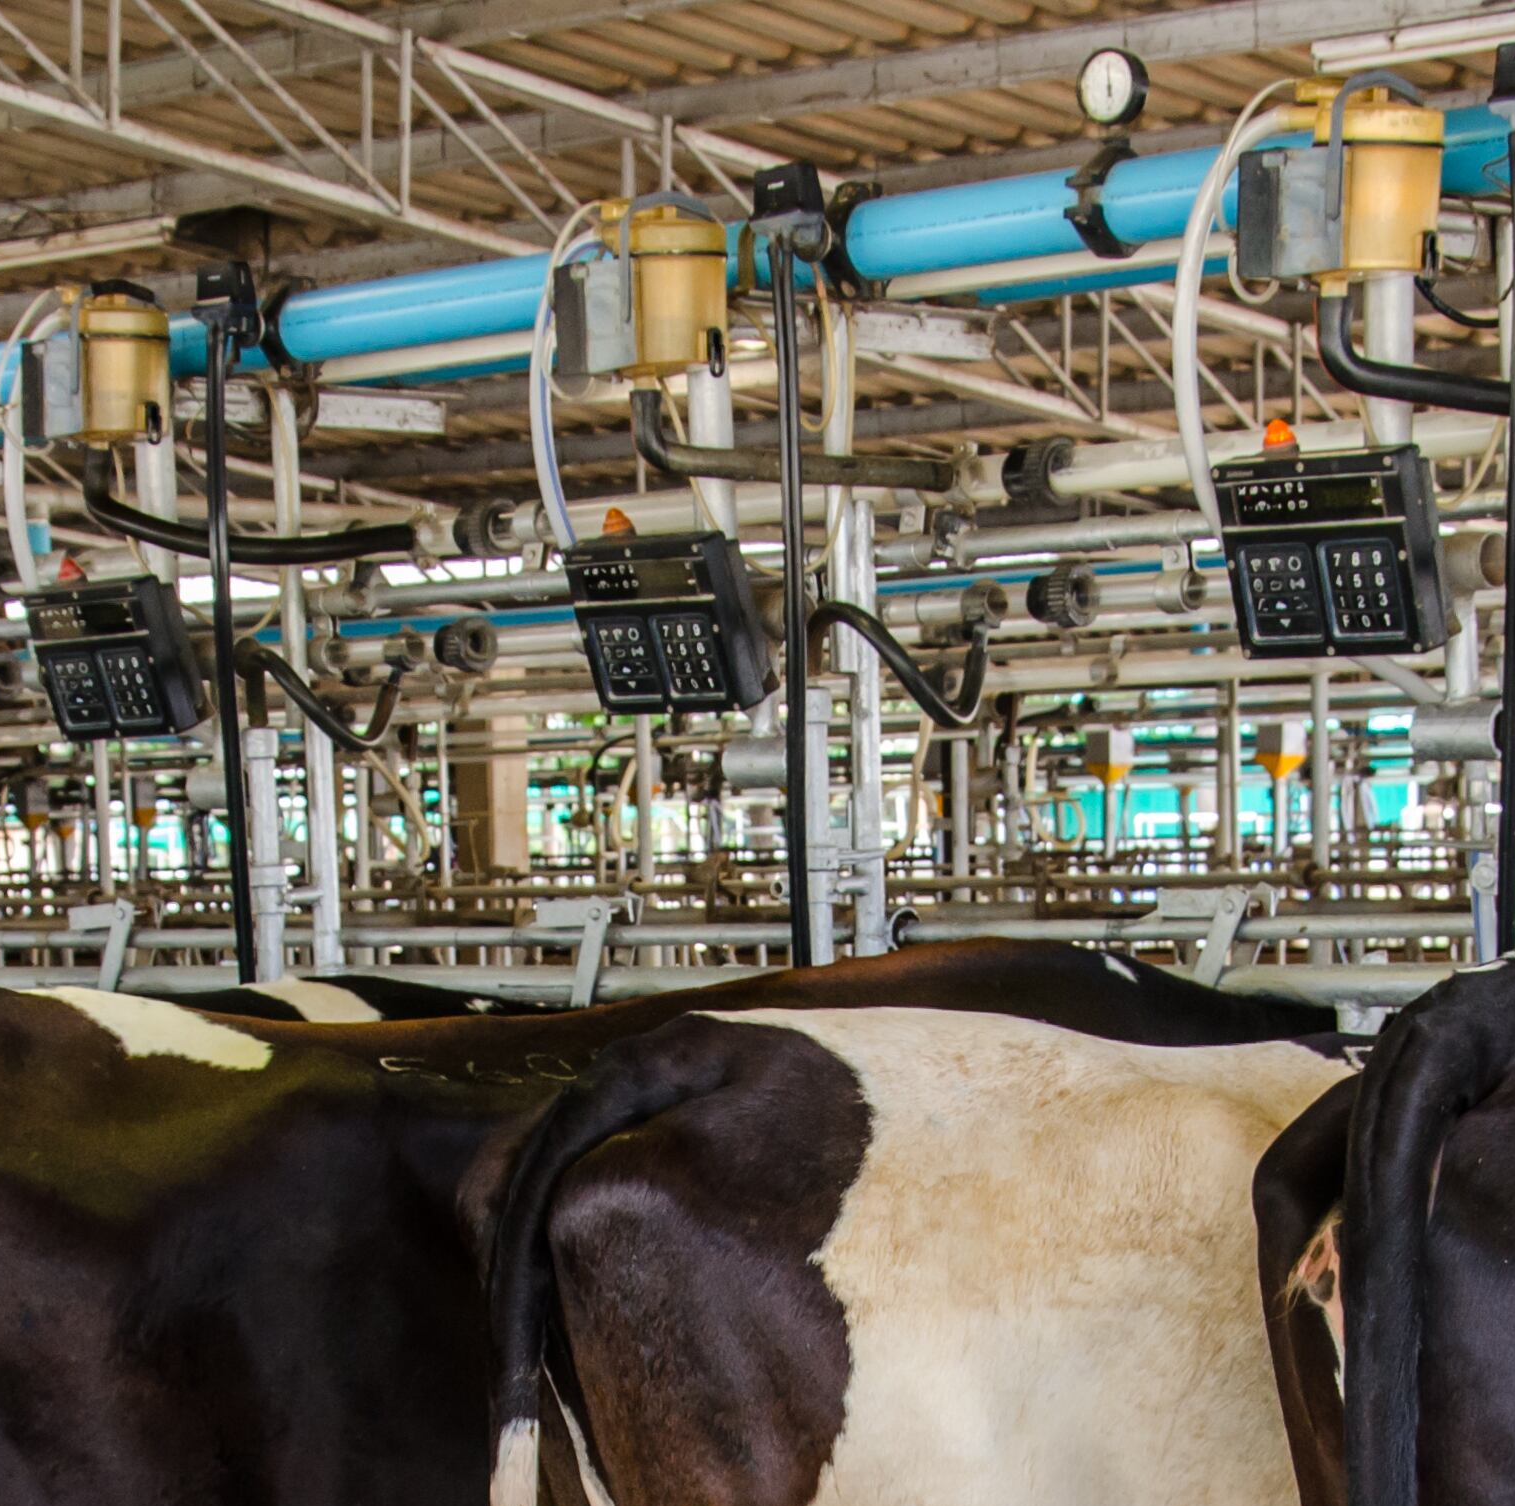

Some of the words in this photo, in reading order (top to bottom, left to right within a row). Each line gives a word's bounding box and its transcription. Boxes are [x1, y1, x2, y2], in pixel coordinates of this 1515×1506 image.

[1333, 552, 1342, 567] 7
[1351, 551, 1361, 567] 8
[1371, 550, 1382, 566] 9
[1352, 573, 1362, 588] 5
[1374, 571, 1385, 587] 6
[1356, 594, 1366, 609] 2
[1378, 592, 1389, 607] 3
[1361, 614, 1372, 628] 0
